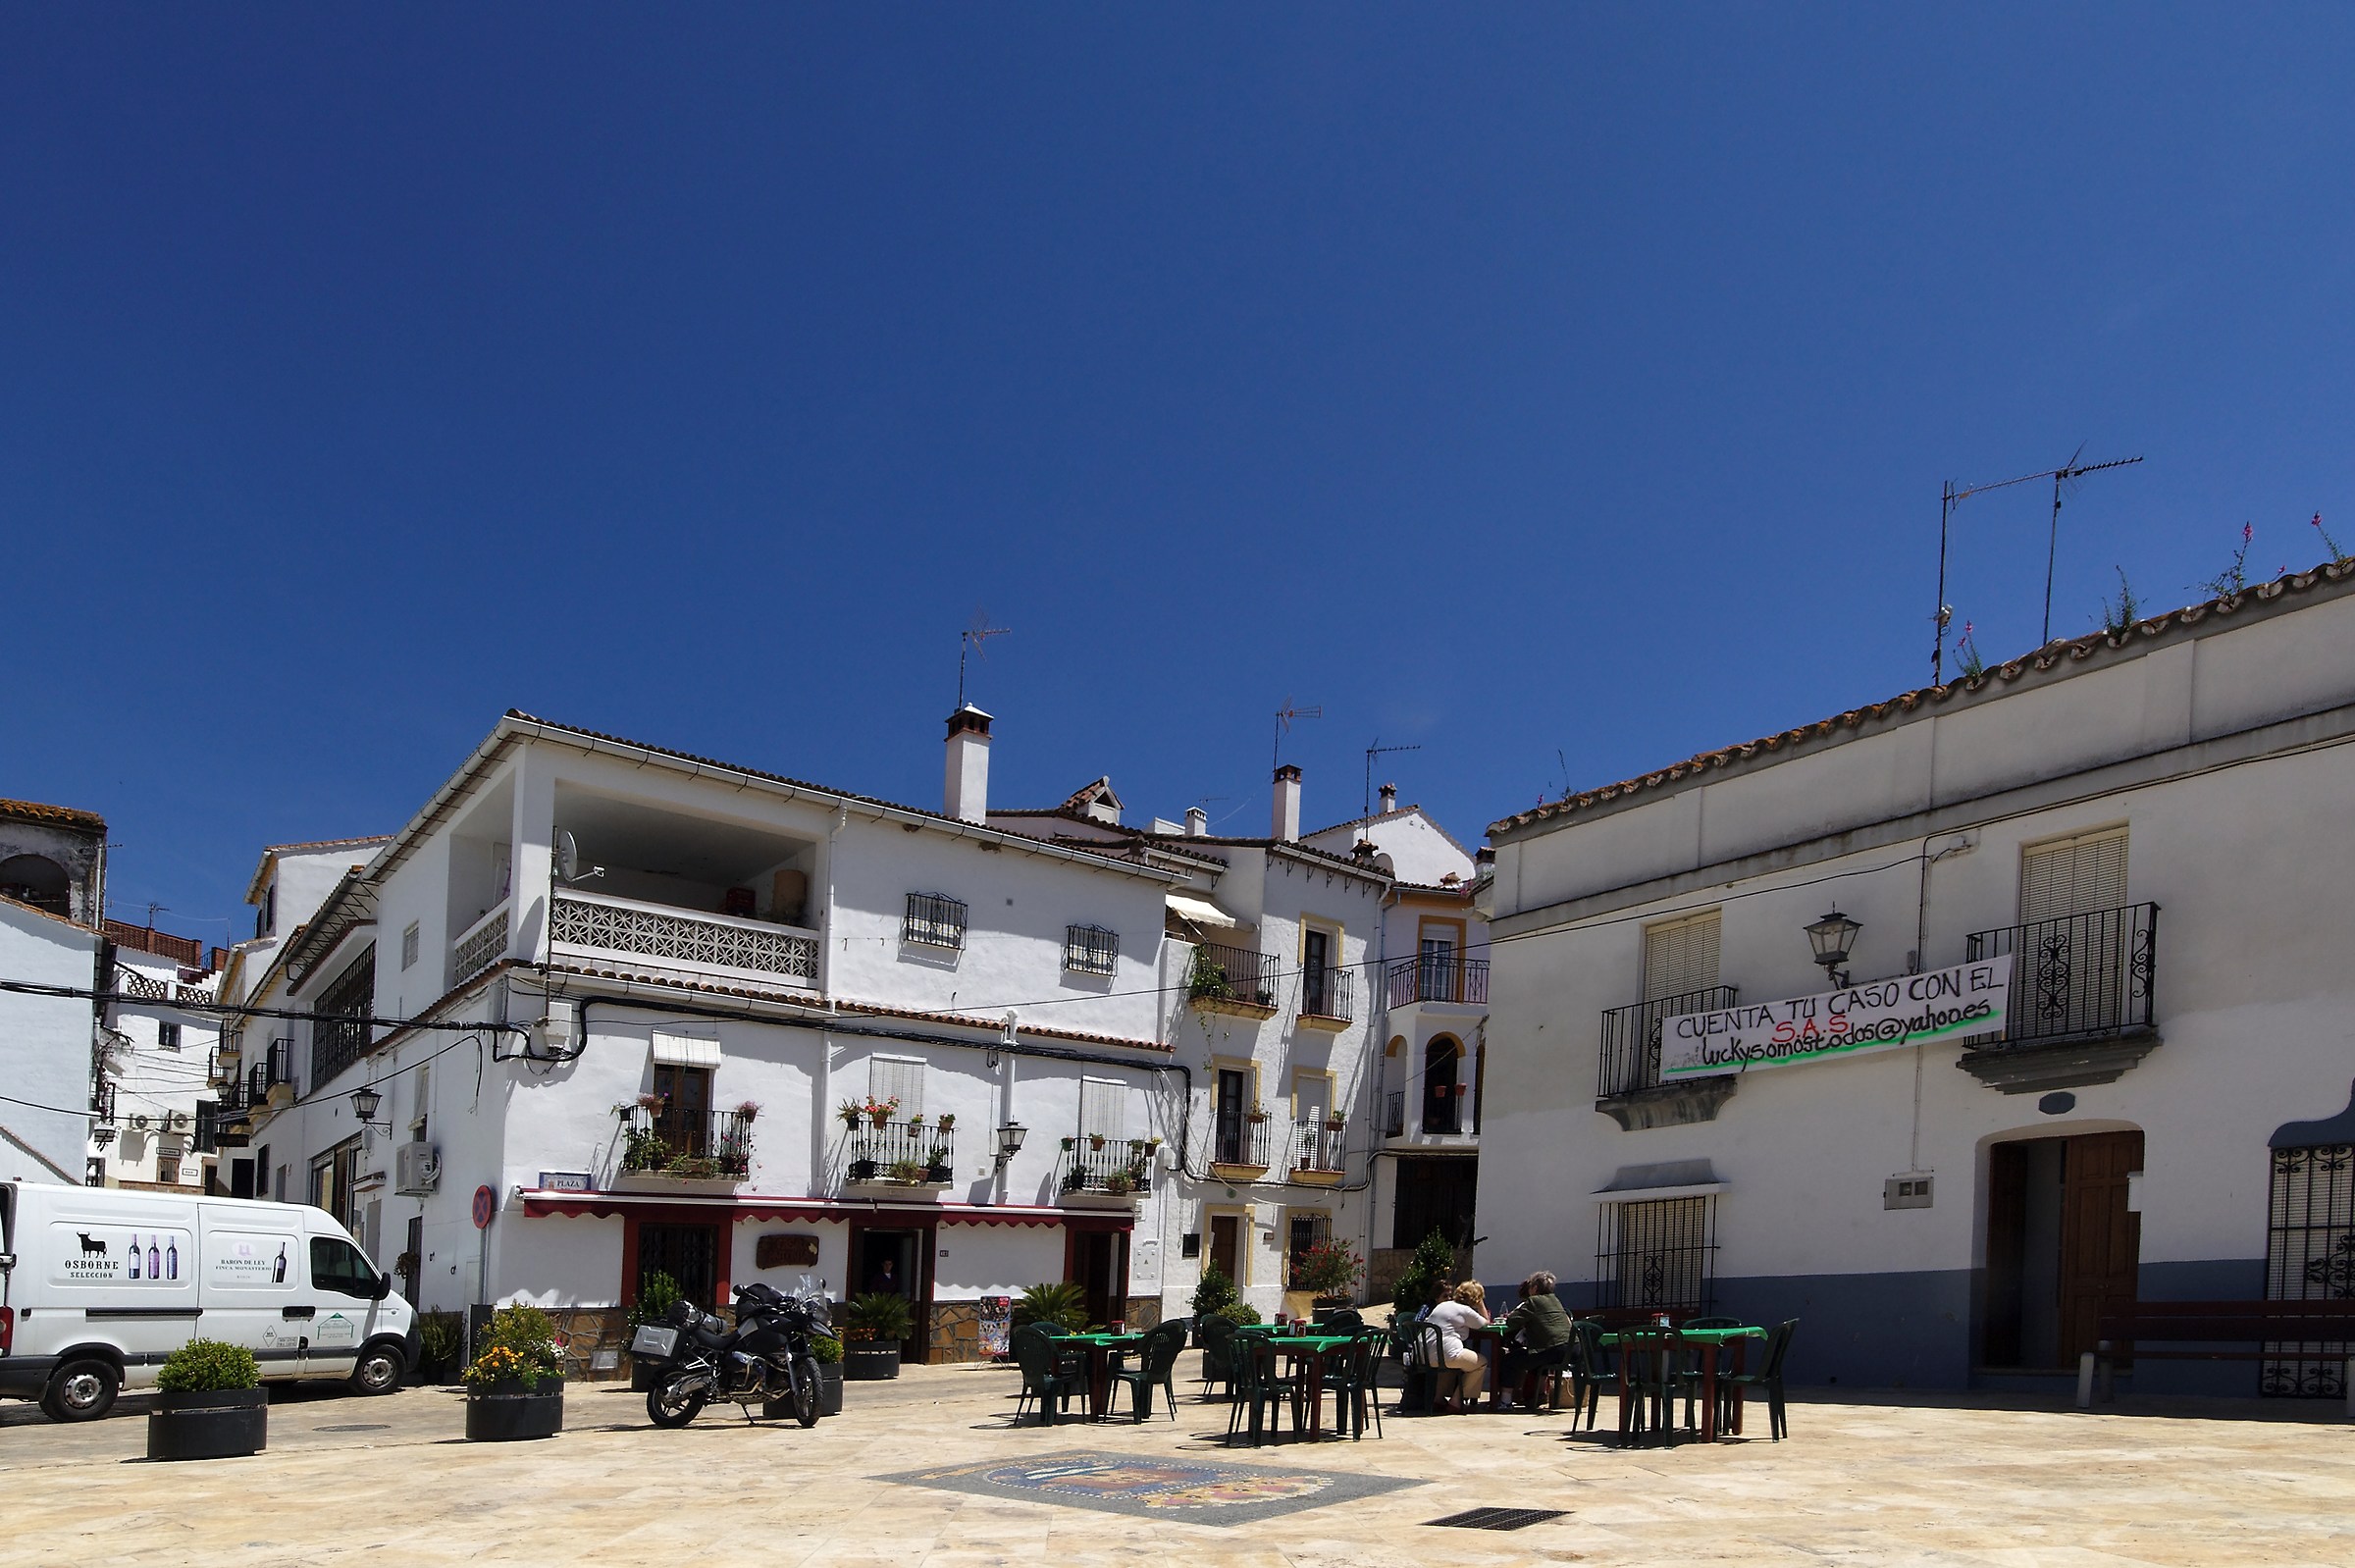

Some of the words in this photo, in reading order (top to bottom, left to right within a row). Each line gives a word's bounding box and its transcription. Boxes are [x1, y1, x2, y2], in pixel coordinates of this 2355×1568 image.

[1677, 1005, 1776, 1039] CUENTA
[1785, 997, 1816, 1020] TU
[1828, 981, 1900, 1016] CASO
[1909, 968, 1962, 1001] CON
[1969, 967, 2005, 992] EL
[65, 1260, 119, 1270] OSBORNE
